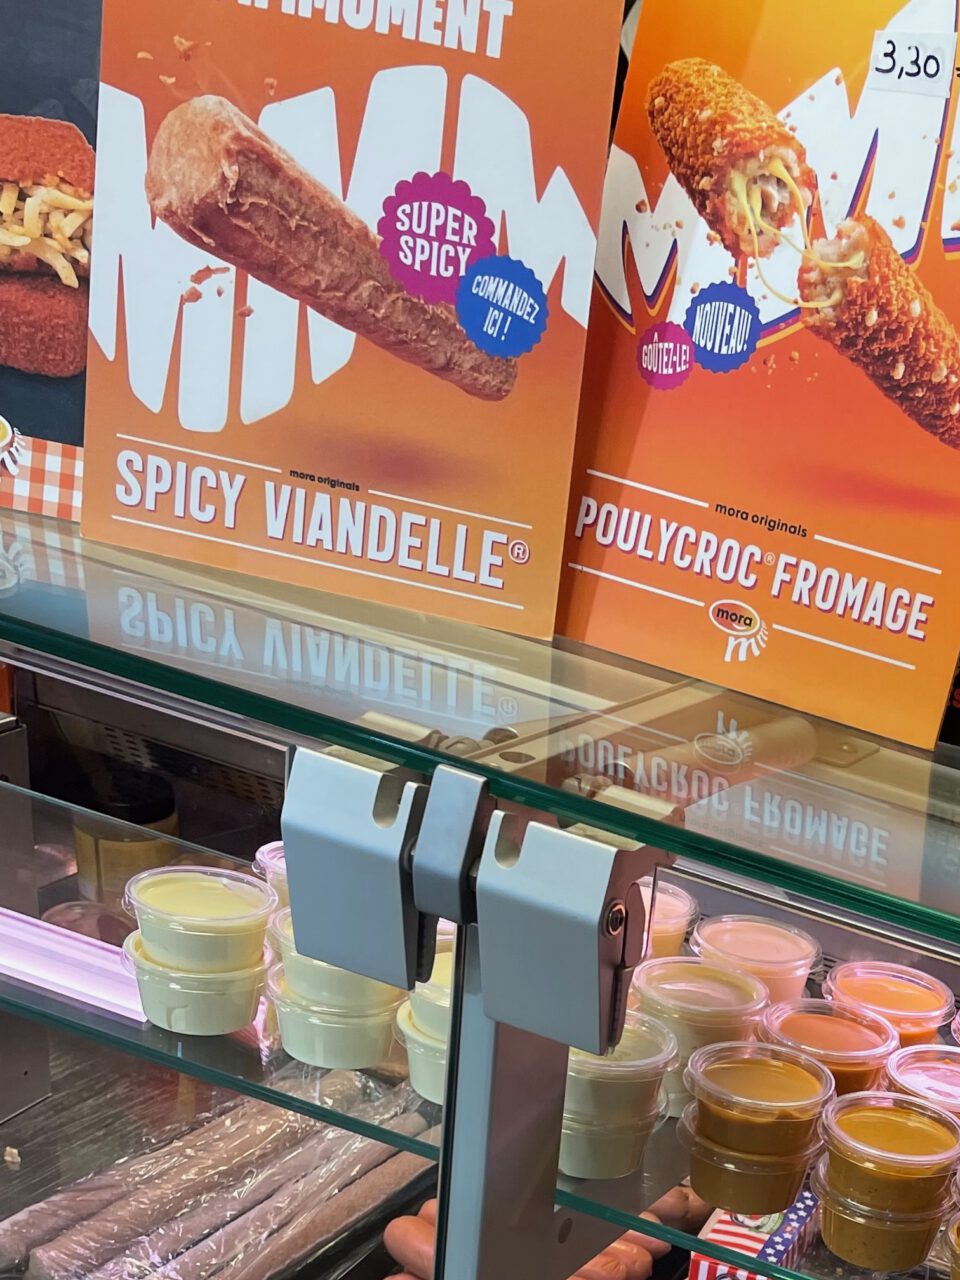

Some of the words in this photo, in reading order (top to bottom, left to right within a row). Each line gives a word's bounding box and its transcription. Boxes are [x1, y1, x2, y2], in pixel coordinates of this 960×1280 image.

[875, 40, 940, 80] 3,30
[396, 201, 478, 246] SUPER
[399, 235, 472, 277] SPICY
[471, 275, 540, 324] COMMANDEZ
[692, 301, 752, 355] NOUVEAU!
[642, 331, 690, 374] GOÛTEZ-LE!
[115, 449, 247, 529] SPICY
[289, 469, 316, 482] mora
[317, 476, 360, 492] originals
[715, 503, 749, 521] mora
[751, 512, 808, 538] originals
[716, 607, 753, 628] mora
[771, 553, 935, 640] FROMAGE
